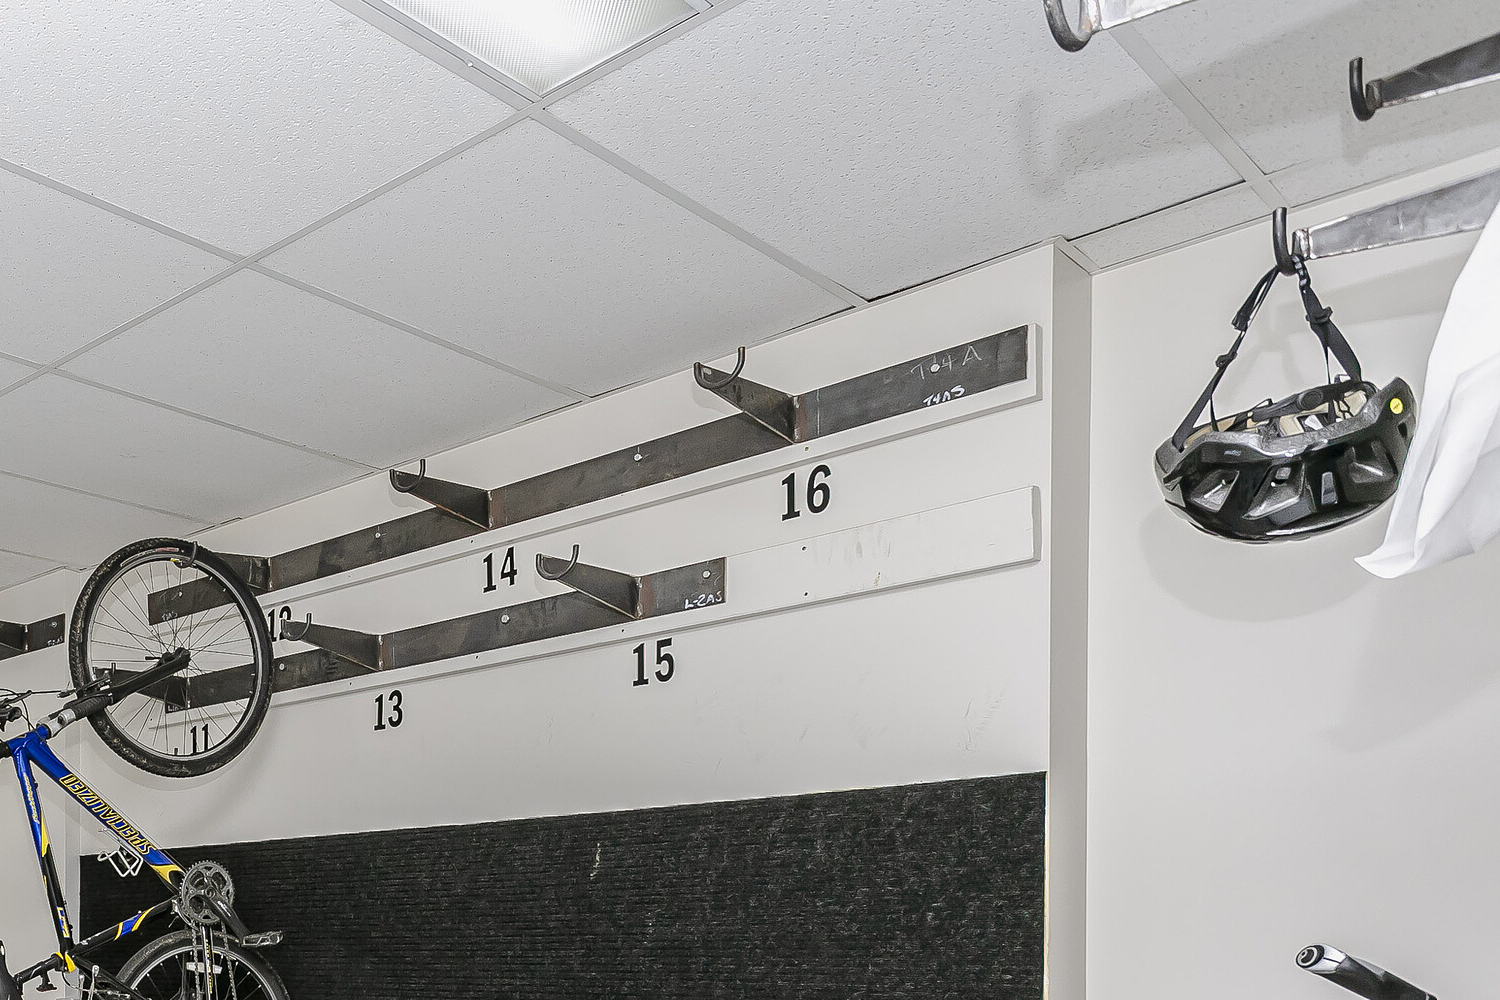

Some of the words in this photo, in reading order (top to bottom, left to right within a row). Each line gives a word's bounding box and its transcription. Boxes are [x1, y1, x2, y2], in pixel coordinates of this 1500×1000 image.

[781, 464, 832, 521] 16
[482, 546, 518, 594] 14
[631, 637, 675, 687] 15
[373, 689, 404, 731] 13
[189, 723, 209, 755] 11
[58, 773, 158, 855] SPECIALIZED
